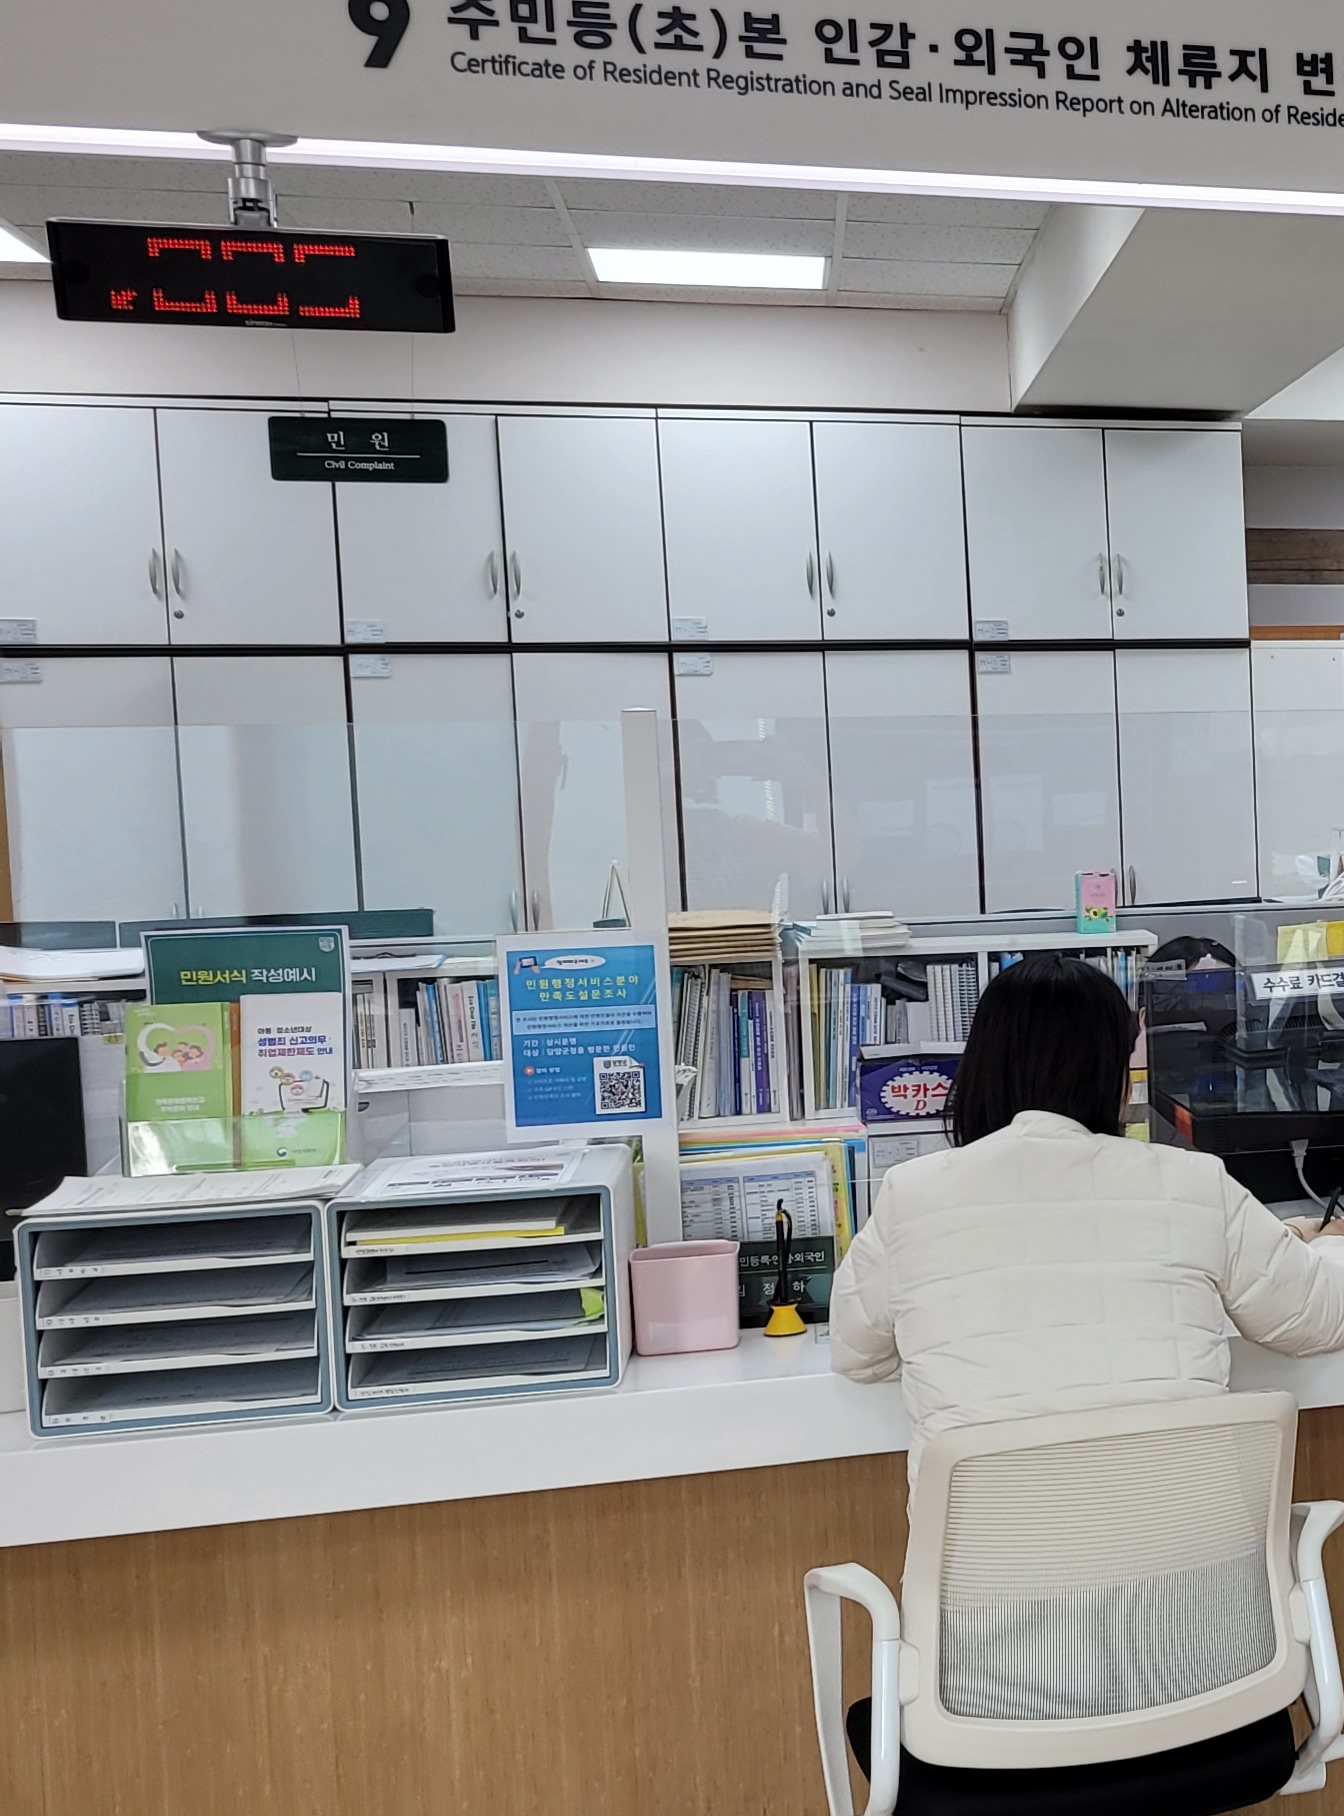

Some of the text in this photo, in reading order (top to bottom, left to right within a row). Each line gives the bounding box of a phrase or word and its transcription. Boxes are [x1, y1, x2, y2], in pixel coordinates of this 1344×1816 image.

[348, 0, 411, 69] 9
[814, 18, 1101, 82] 인감·외국인
[1126, 40, 1270, 93] 체류지
[450, 51, 565, 80] Certificate
[573, 59, 596, 81] of
[602, 62, 700, 88] Resident
[706, 70, 836, 97] Registration
[842, 77, 882, 100] and
[888, 80, 932, 103] Seal
[939, 84, 1049, 110] Impression
[1055, 90, 1124, 116] Report
[1129, 98, 1155, 116] on
[1161, 98, 1256, 122] Alteration
[1261, 102, 1282, 124] of
[324, 459, 395, 472] Civil Complaint
[180, 967, 316, 985] 민원서식 작성예시
[1262, 974, 1302, 992] 수수료
[316, 1047, 334, 1056] 안내
[890, 1082, 949, 1100] 박카스
[914, 1099, 928, 1111] D
